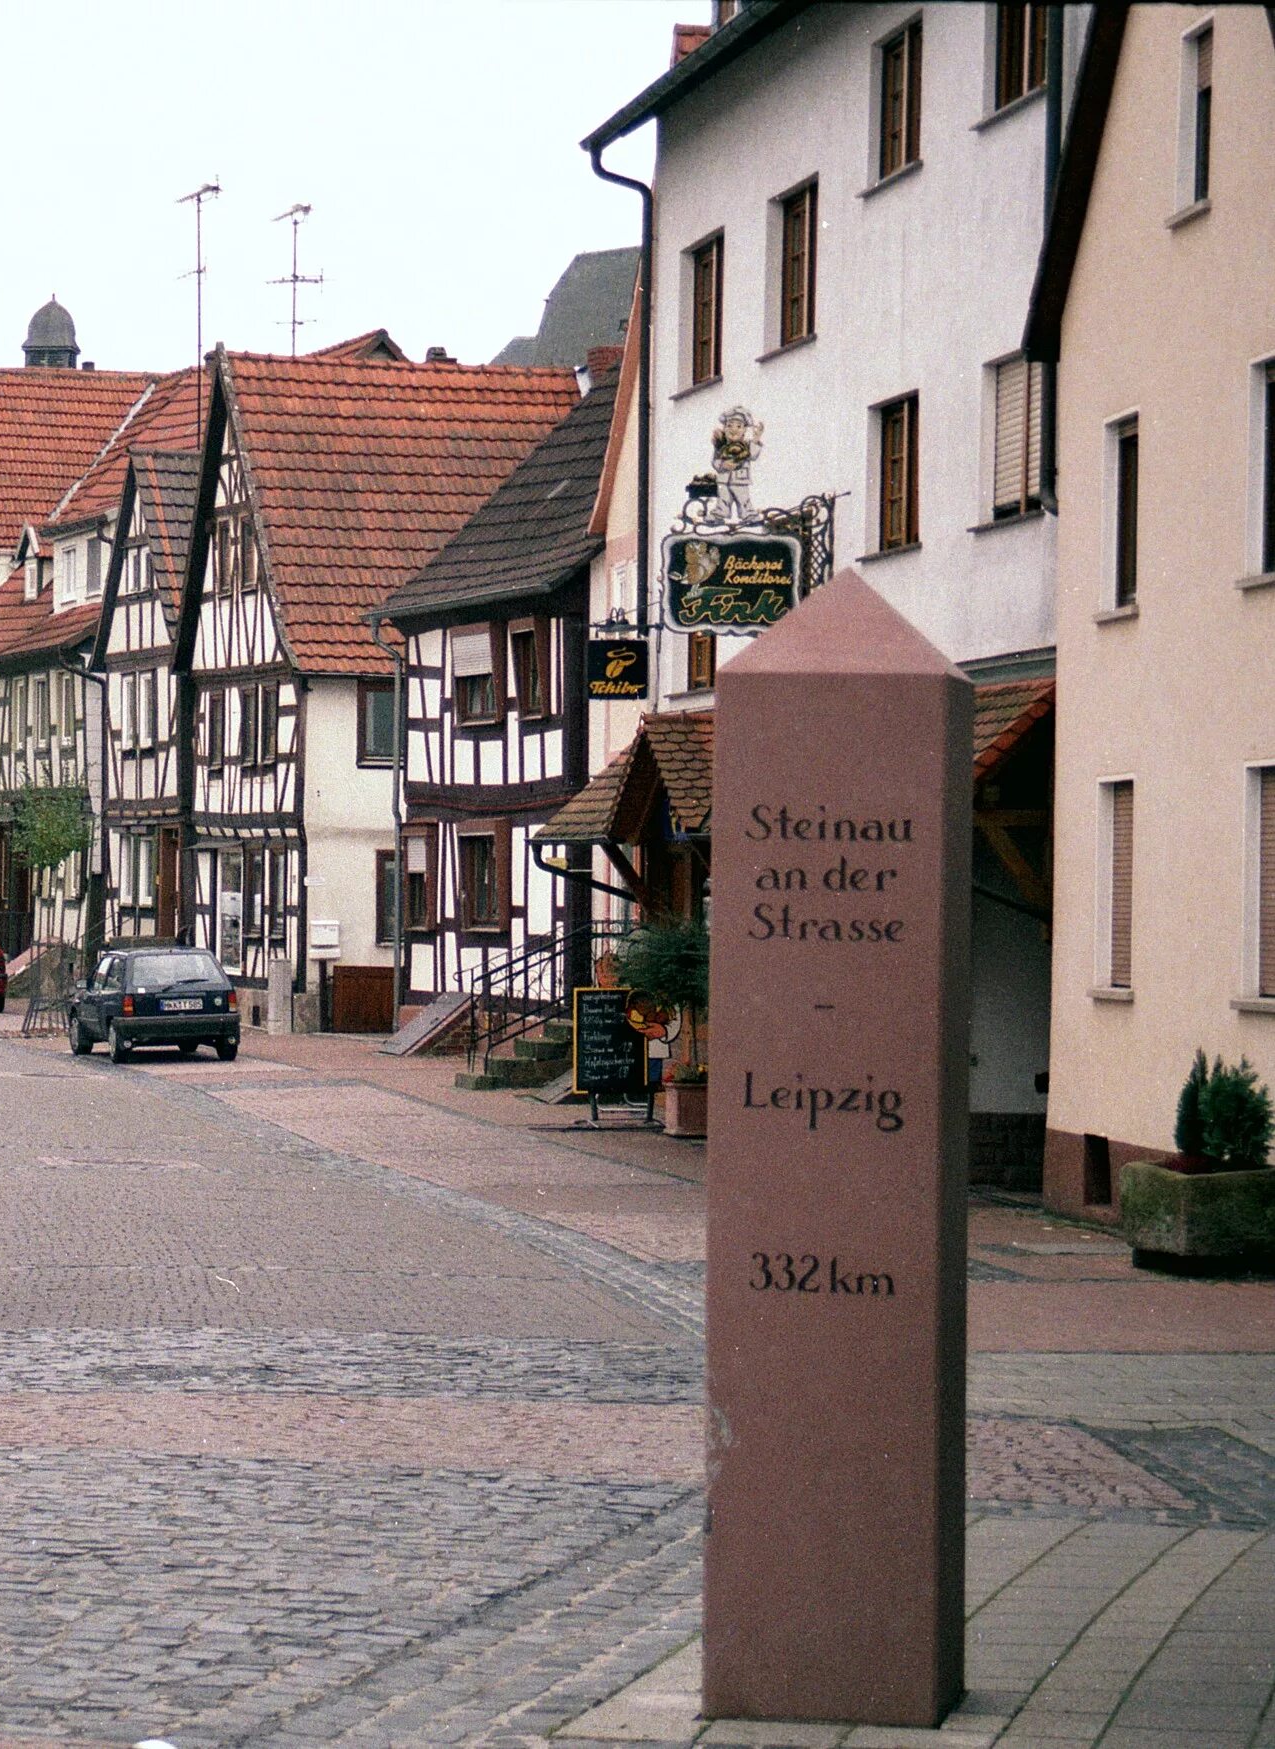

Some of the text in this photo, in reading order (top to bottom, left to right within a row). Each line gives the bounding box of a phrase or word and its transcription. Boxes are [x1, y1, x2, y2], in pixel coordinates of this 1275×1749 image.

[724, 555, 784, 570] Bäckerei
[724, 571, 792, 585] Konditorei
[589, 681, 645, 695] Tchibo
[744, 803, 913, 843] Steinau
[755, 856, 897, 893] an der
[747, 901, 905, 942] Strasse
[742, 1070, 905, 1133] Leipzig
